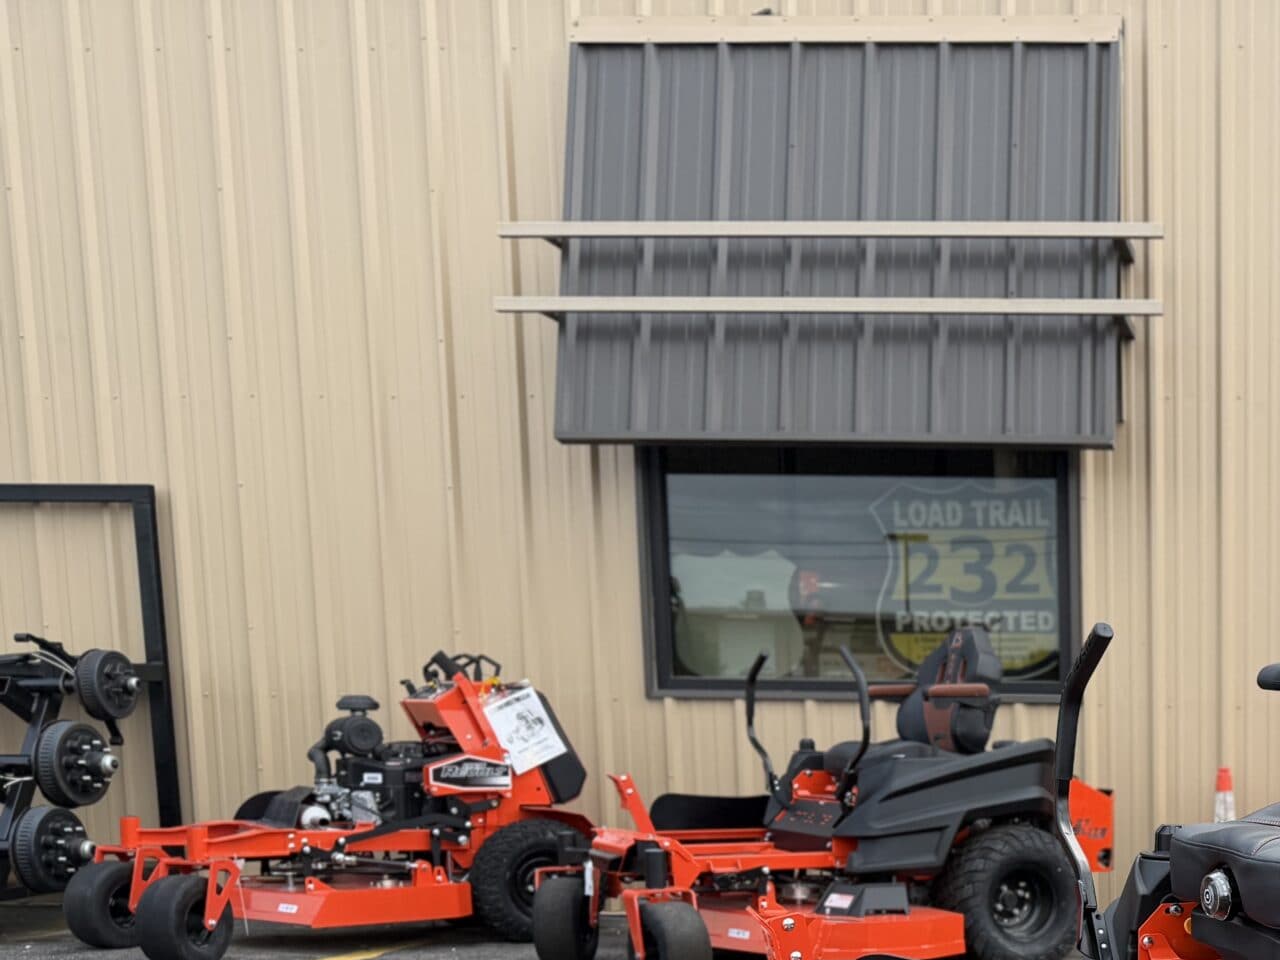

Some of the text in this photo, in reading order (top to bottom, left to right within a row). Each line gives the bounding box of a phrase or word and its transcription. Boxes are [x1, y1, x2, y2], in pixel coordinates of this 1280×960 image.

[893, 500, 1051, 527] LOAD TRAIL
[907, 535, 1041, 603] 232
[895, 610, 1055, 632] PROTECTED
